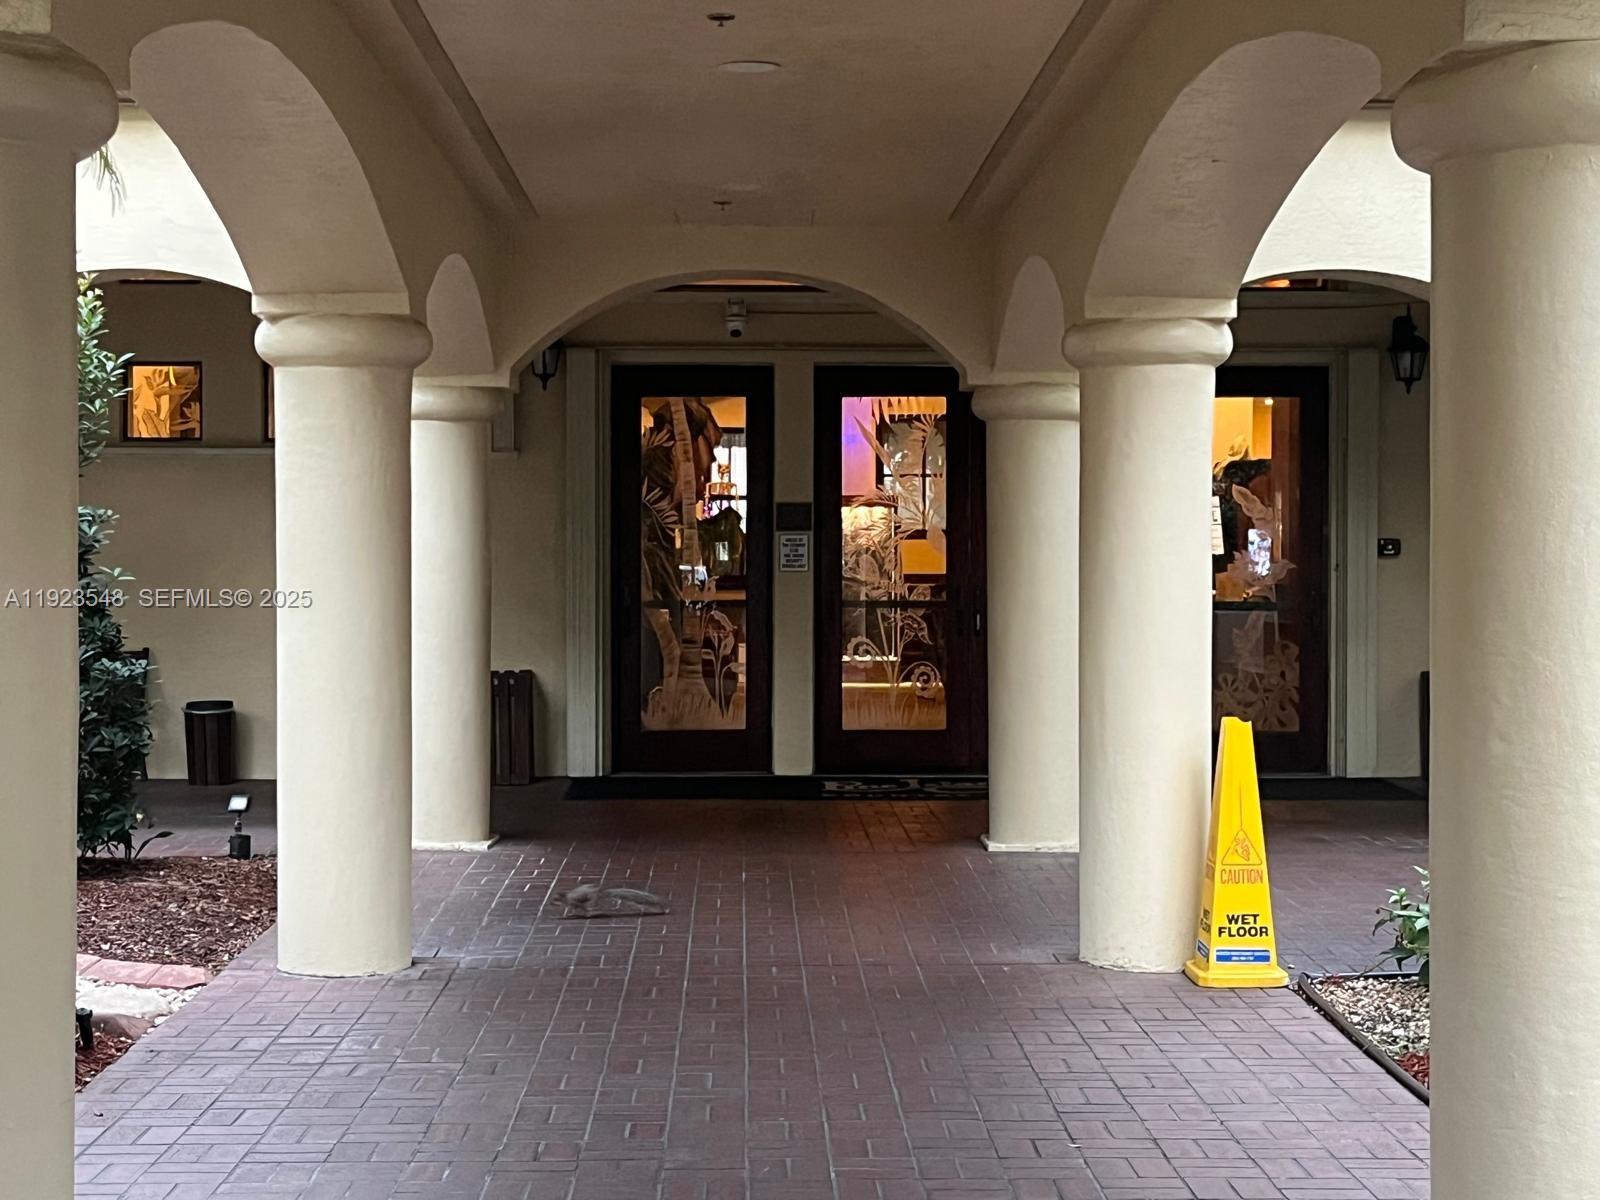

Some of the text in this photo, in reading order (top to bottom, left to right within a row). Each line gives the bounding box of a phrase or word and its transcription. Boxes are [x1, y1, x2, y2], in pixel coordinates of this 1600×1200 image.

[1220, 868, 1264, 885] CAUTION
[1226, 914, 1260, 925] WET
[1218, 926, 1269, 938] FLOOR
